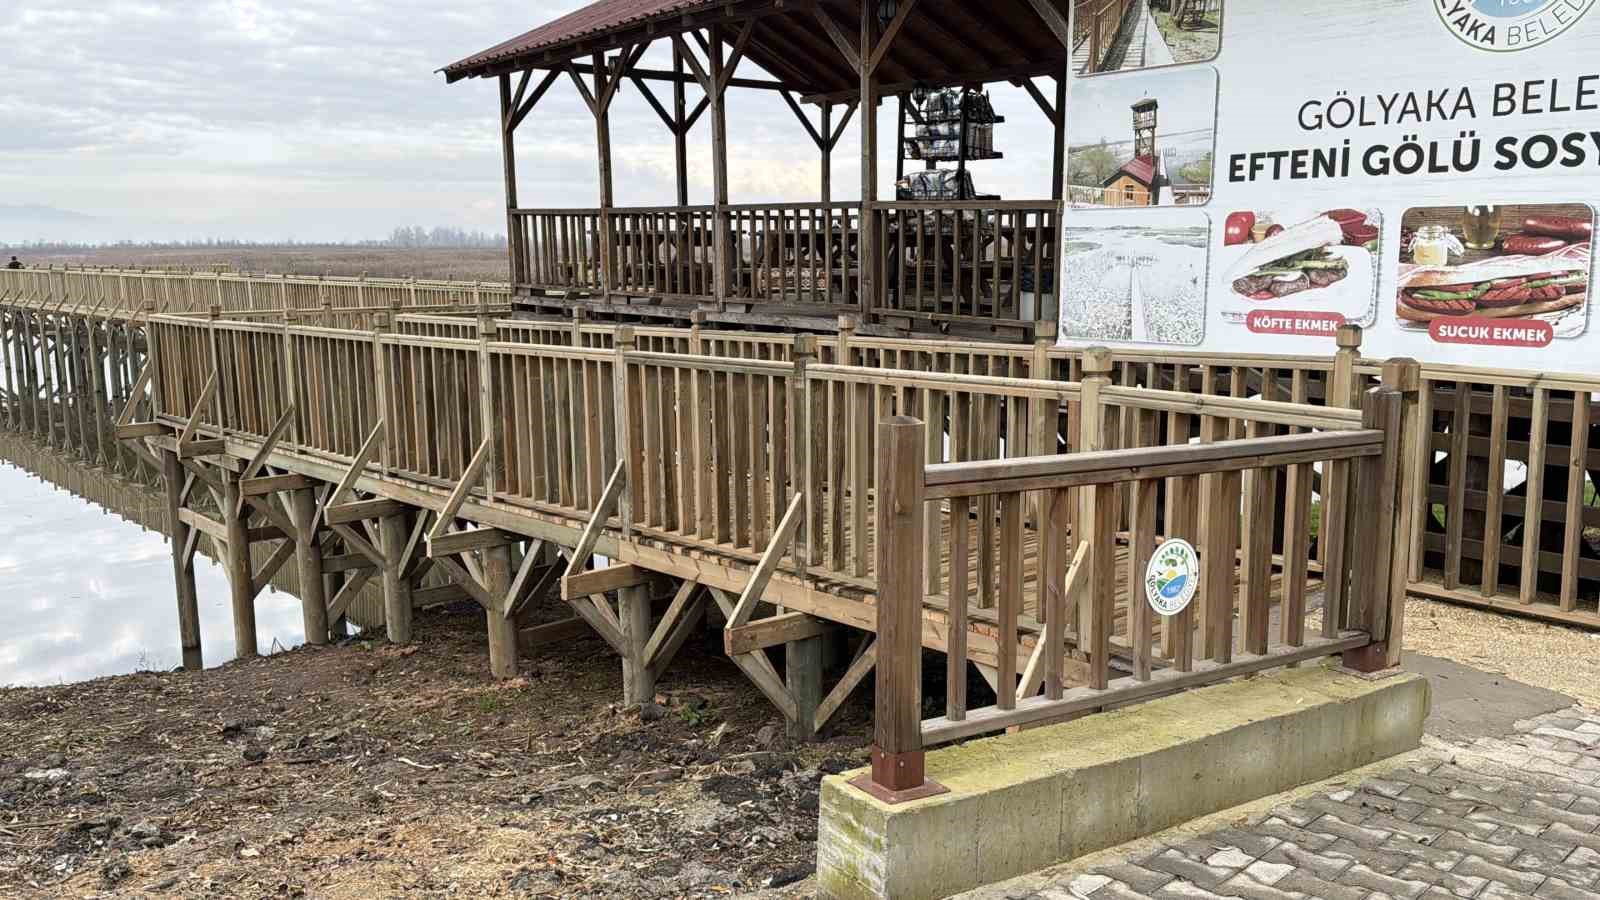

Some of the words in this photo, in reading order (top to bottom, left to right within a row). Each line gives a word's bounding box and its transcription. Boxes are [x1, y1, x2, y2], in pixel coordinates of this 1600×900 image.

[1298, 86, 1477, 130] GÖLYAKA
[1492, 74, 1600, 117] BELE
[1228, 138, 1350, 182] EFTENİ
[1362, 130, 1481, 176] GÖLÜ
[1253, 315, 1292, 329] KÖFTE
[1295, 318, 1339, 332] EKMEK
[1439, 324, 1489, 339] SUCUK
[1493, 327, 1547, 342] EKMEK
